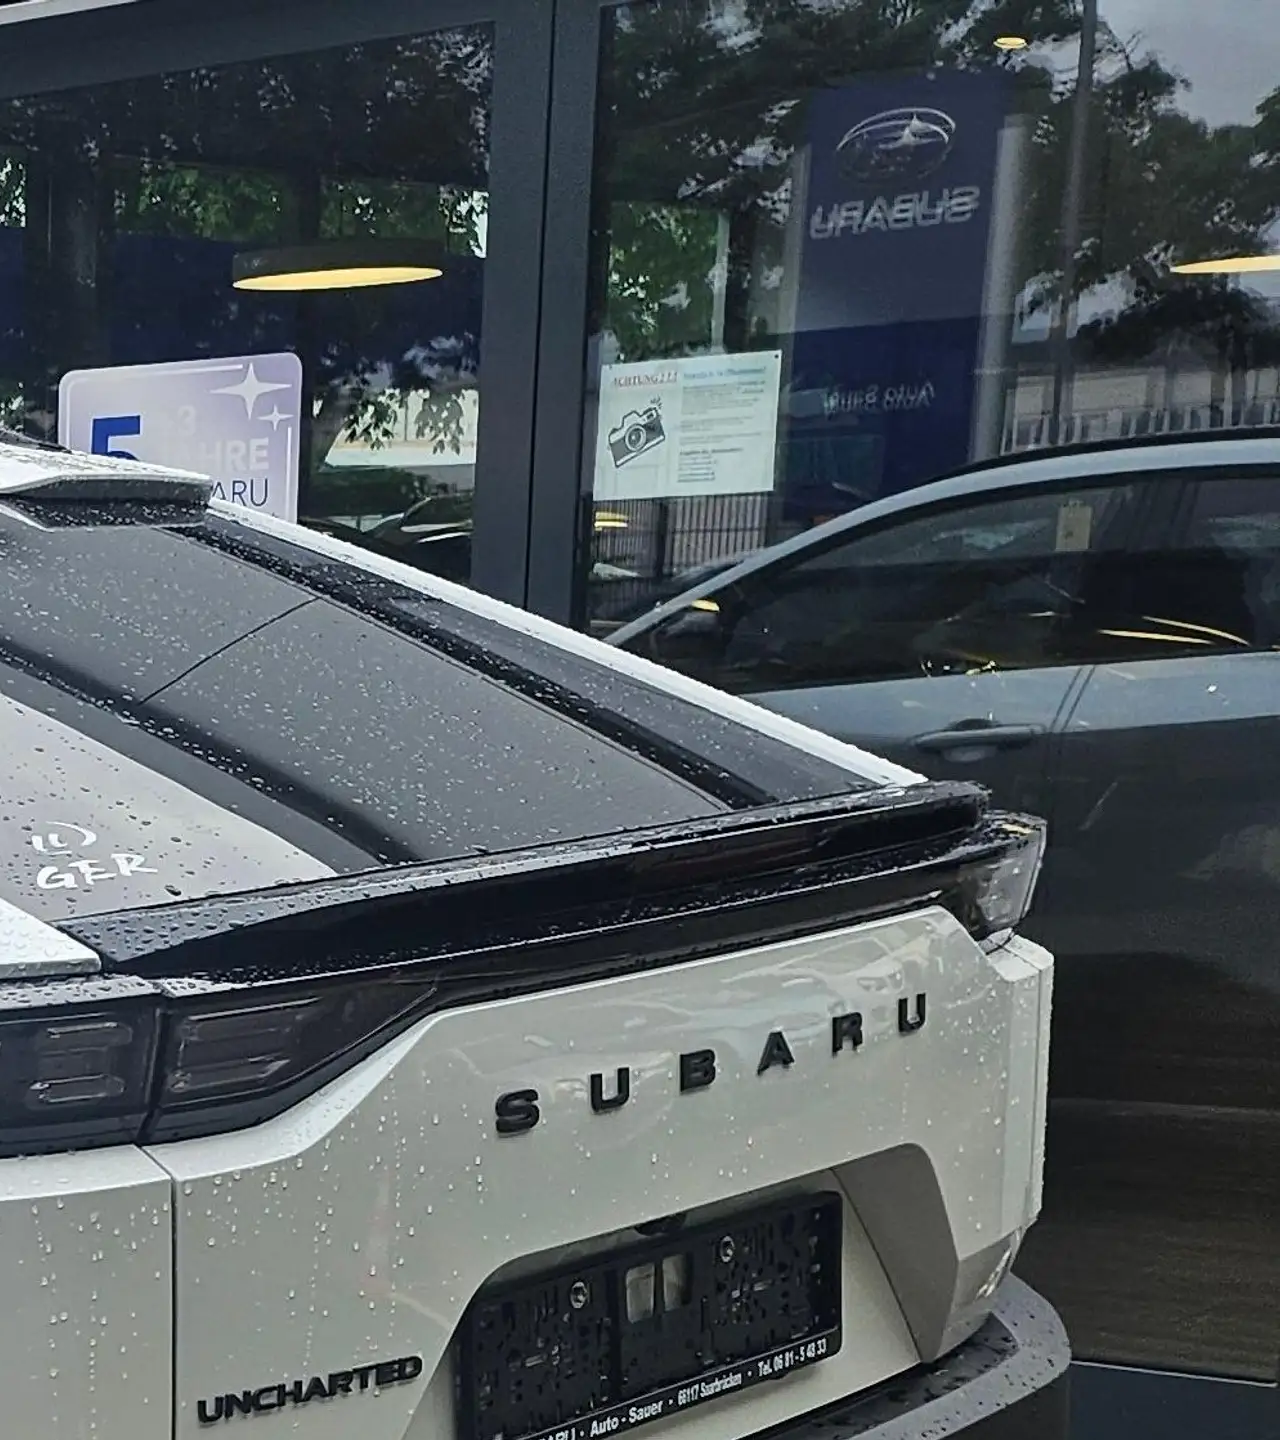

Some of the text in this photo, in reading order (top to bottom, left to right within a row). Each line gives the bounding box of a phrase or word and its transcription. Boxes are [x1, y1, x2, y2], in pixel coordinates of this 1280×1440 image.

[495, 992, 927, 1135] SUBARU
[197, 1355, 424, 1423] UNCHARTED
[590, 1416, 619, 1438] Auto
[628, 1401, 664, 1423] Sauer
